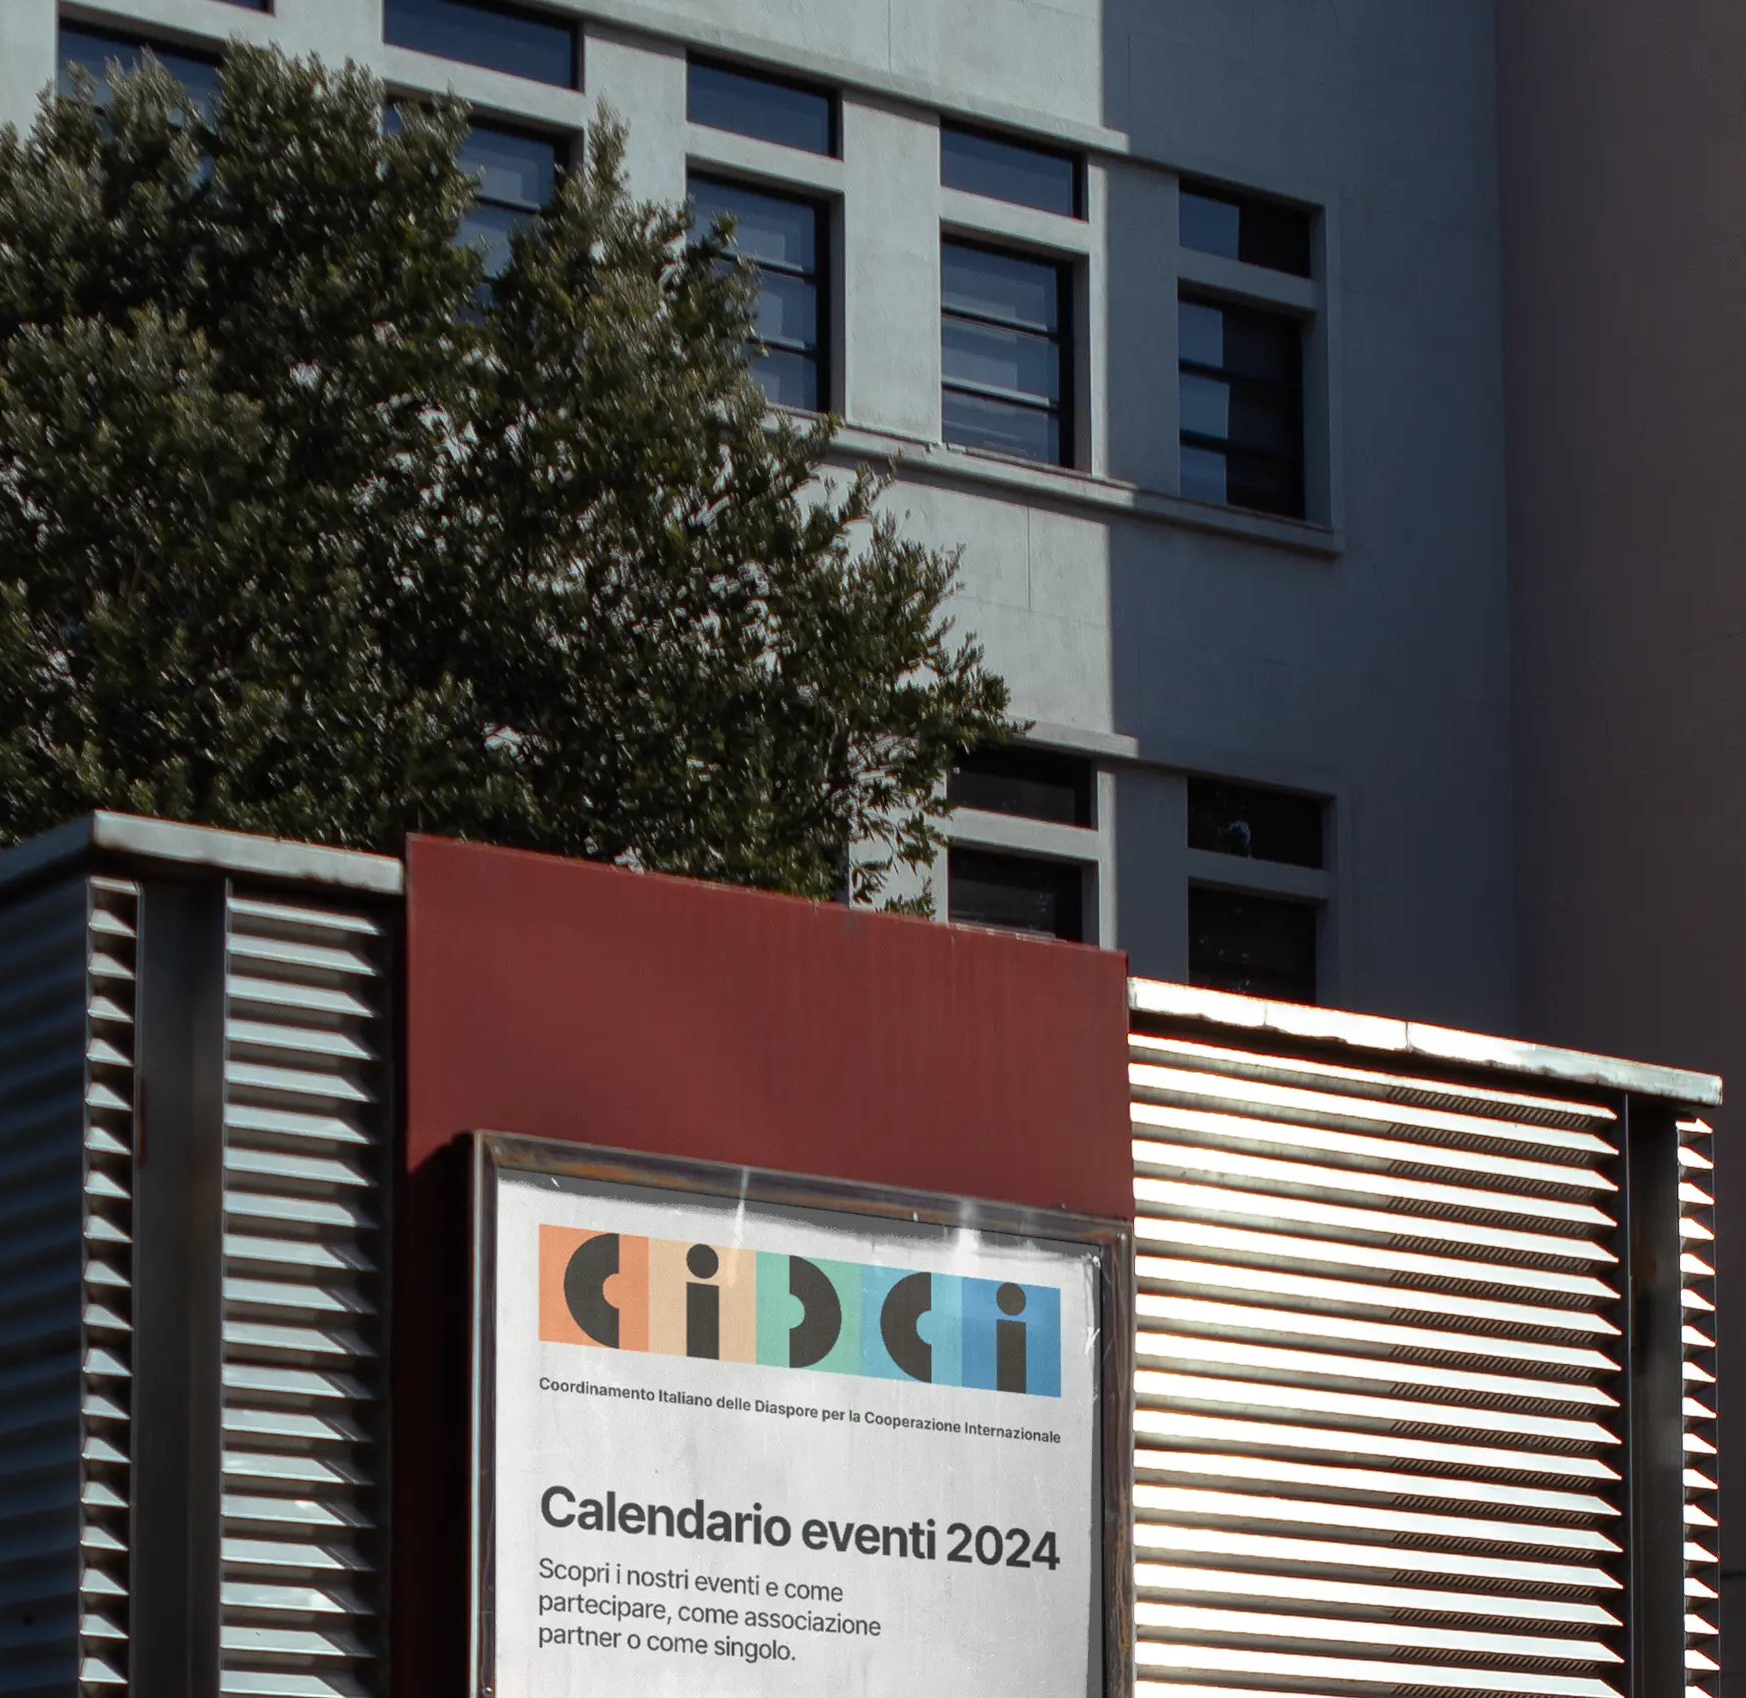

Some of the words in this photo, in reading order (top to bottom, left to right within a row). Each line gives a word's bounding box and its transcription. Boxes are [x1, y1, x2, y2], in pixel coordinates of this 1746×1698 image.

[540, 1377, 655, 1401] Coordinamento
[659, 1390, 712, 1407] Italiano
[716, 1396, 751, 1411] delle
[755, 1400, 818, 1418] Diaspore
[822, 1409, 845, 1422] per
[849, 1410, 860, 1422] la
[864, 1412, 961, 1433] Cooperazione
[965, 1422, 1060, 1443] Internazionale
[541, 1486, 791, 1547] Calendario
[802, 1518, 935, 1560] eventi
[947, 1523, 1060, 1570] 2024
[539, 1558, 610, 1587] Scopri
[627, 1569, 688, 1590] nostri
[695, 1575, 759, 1595] eventi
[766, 1582, 778, 1597] e
[785, 1583, 843, 1602] come
[539, 1594, 671, 1625] partecipare,
[678, 1606, 738, 1625] come
[745, 1611, 881, 1636] associazione
[539, 1626, 622, 1648] partner
[627, 1634, 641, 1649] o
[647, 1635, 708, 1654] come
[714, 1636, 795, 1663] singolo.
